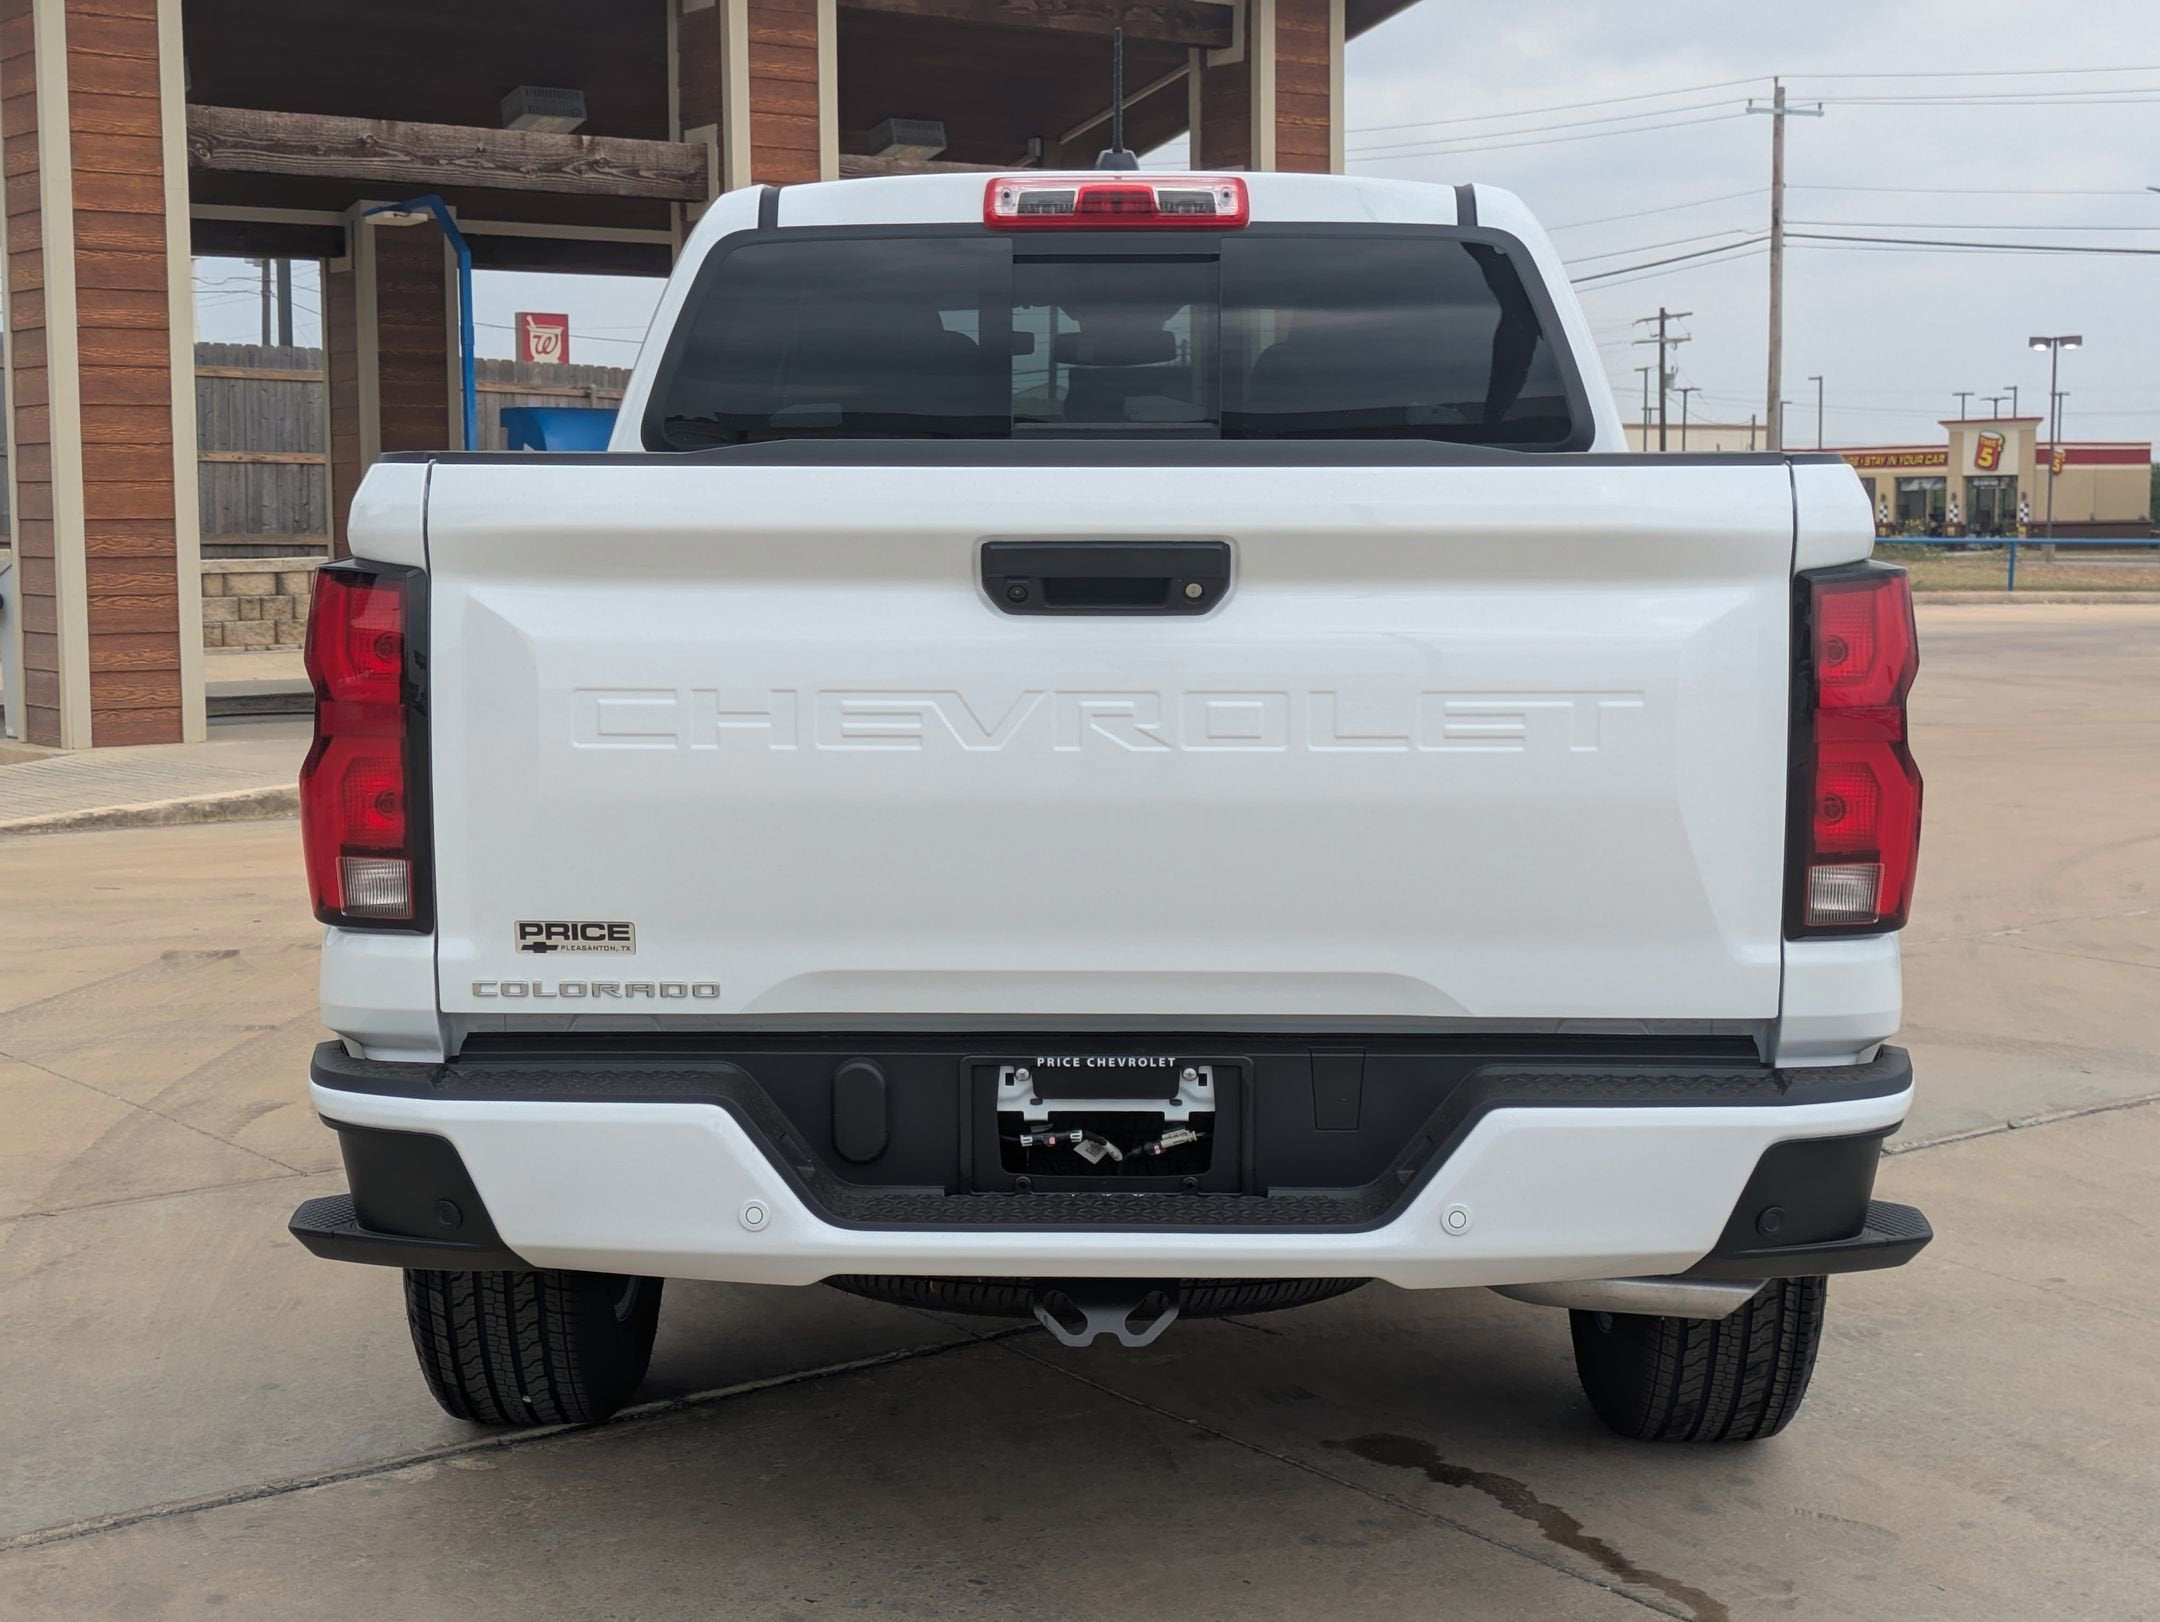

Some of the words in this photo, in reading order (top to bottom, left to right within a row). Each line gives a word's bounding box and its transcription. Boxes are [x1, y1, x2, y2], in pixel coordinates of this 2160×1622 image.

[1864, 456, 1886, 466] STAY
[1888, 455, 1898, 465] IN
[1899, 454, 1924, 465] YOUR
[1925, 453, 1946, 464] CAR
[1977, 447, 1993, 468] 5
[569, 687, 1645, 753] CHEVROLET
[519, 923, 631, 941] PRICE
[560, 944, 618, 953] PLEASANTON,
[472, 981, 720, 999] COLORADO
[1037, 1057, 1081, 1068] PRICE
[1086, 1056, 1176, 1068] CHEVROLET
